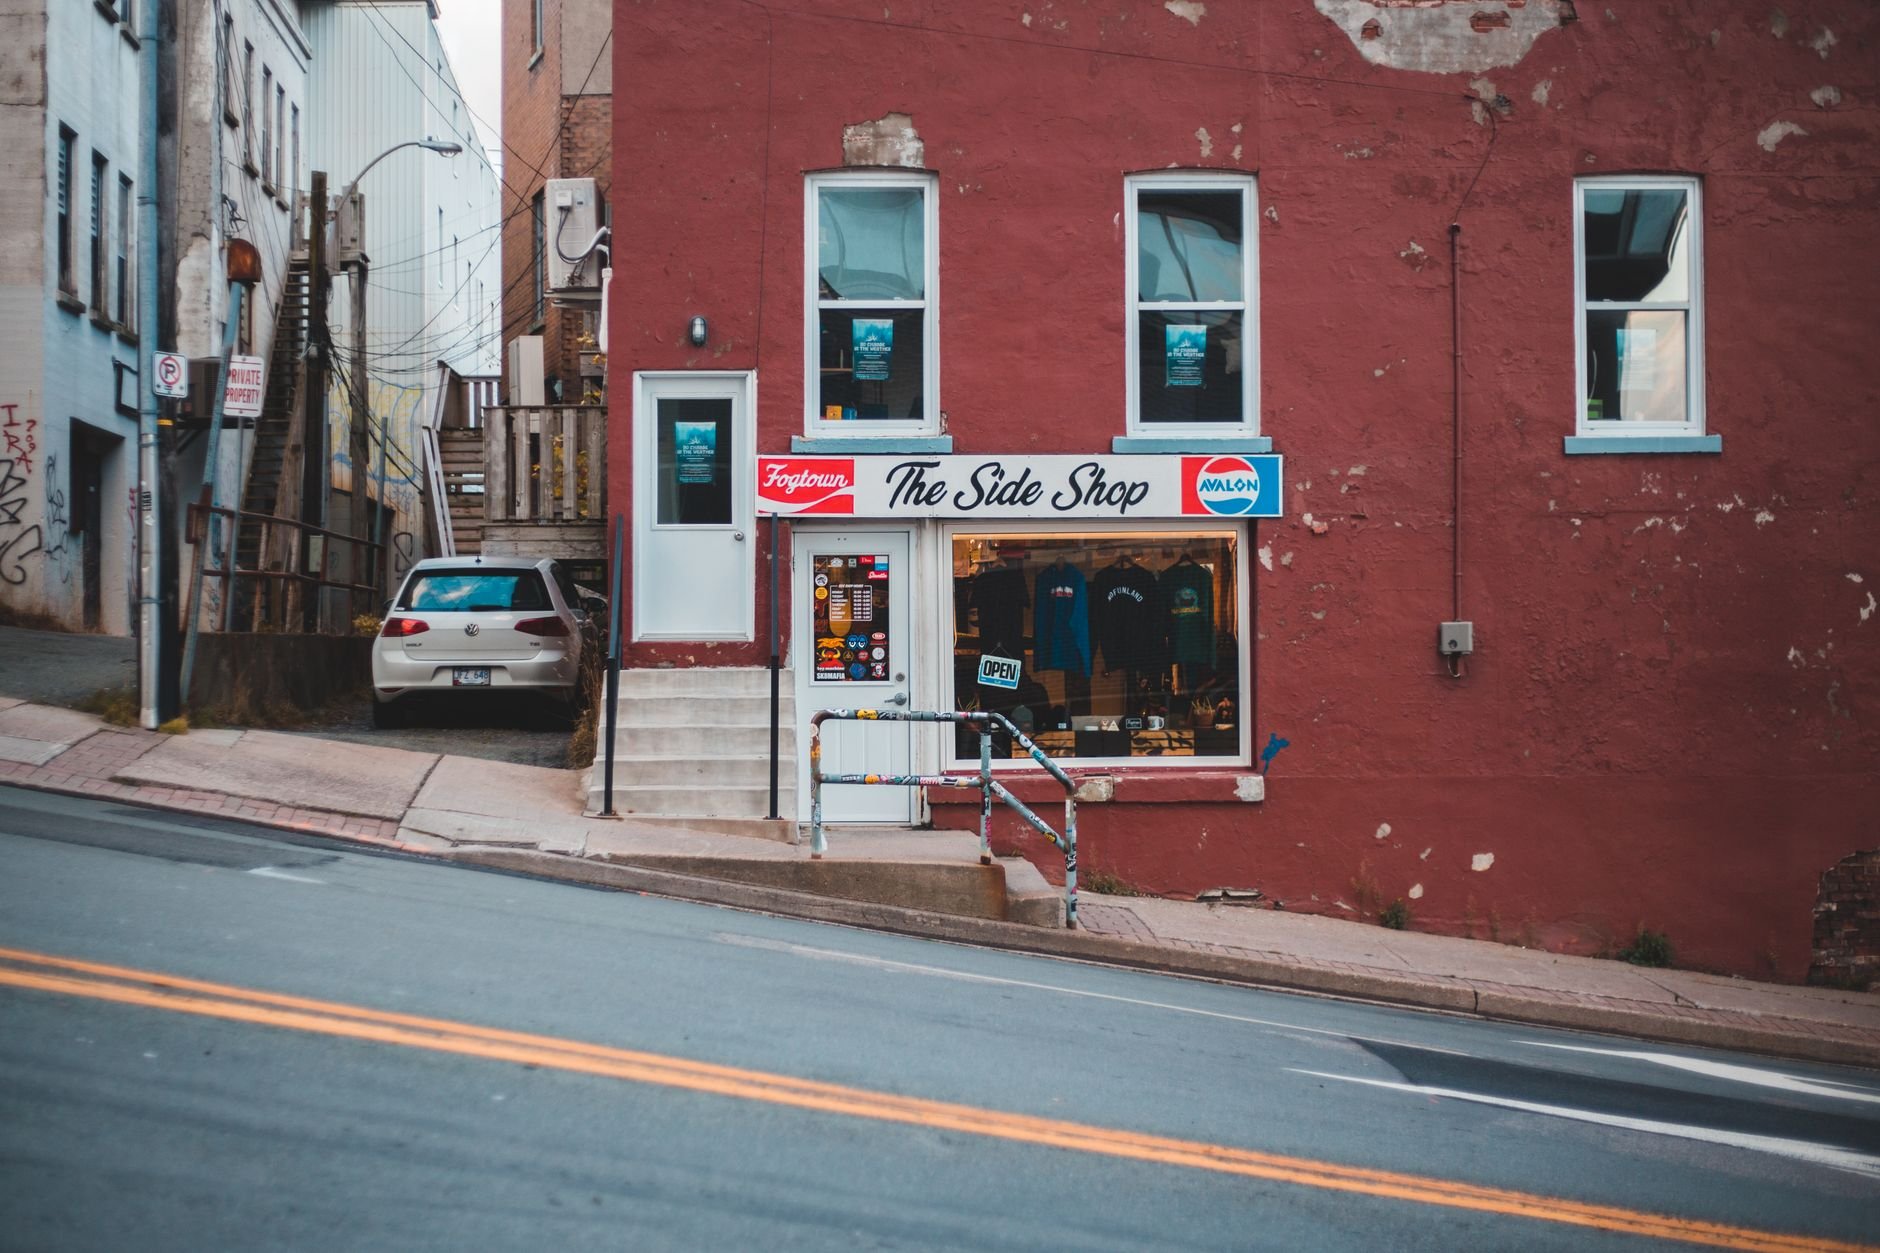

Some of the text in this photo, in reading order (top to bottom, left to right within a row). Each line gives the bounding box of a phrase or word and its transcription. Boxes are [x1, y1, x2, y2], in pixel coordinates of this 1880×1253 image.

[227, 368, 262, 386] PRIVATE
[225, 387, 261, 405] PROPERTY
[762, 464, 849, 495] Fogtown
[886, 460, 1150, 515] The Side Shop
[1199, 476, 1260, 494] AVALON
[474, 670, 489, 680] 648
[983, 659, 1017, 681] OPEN
